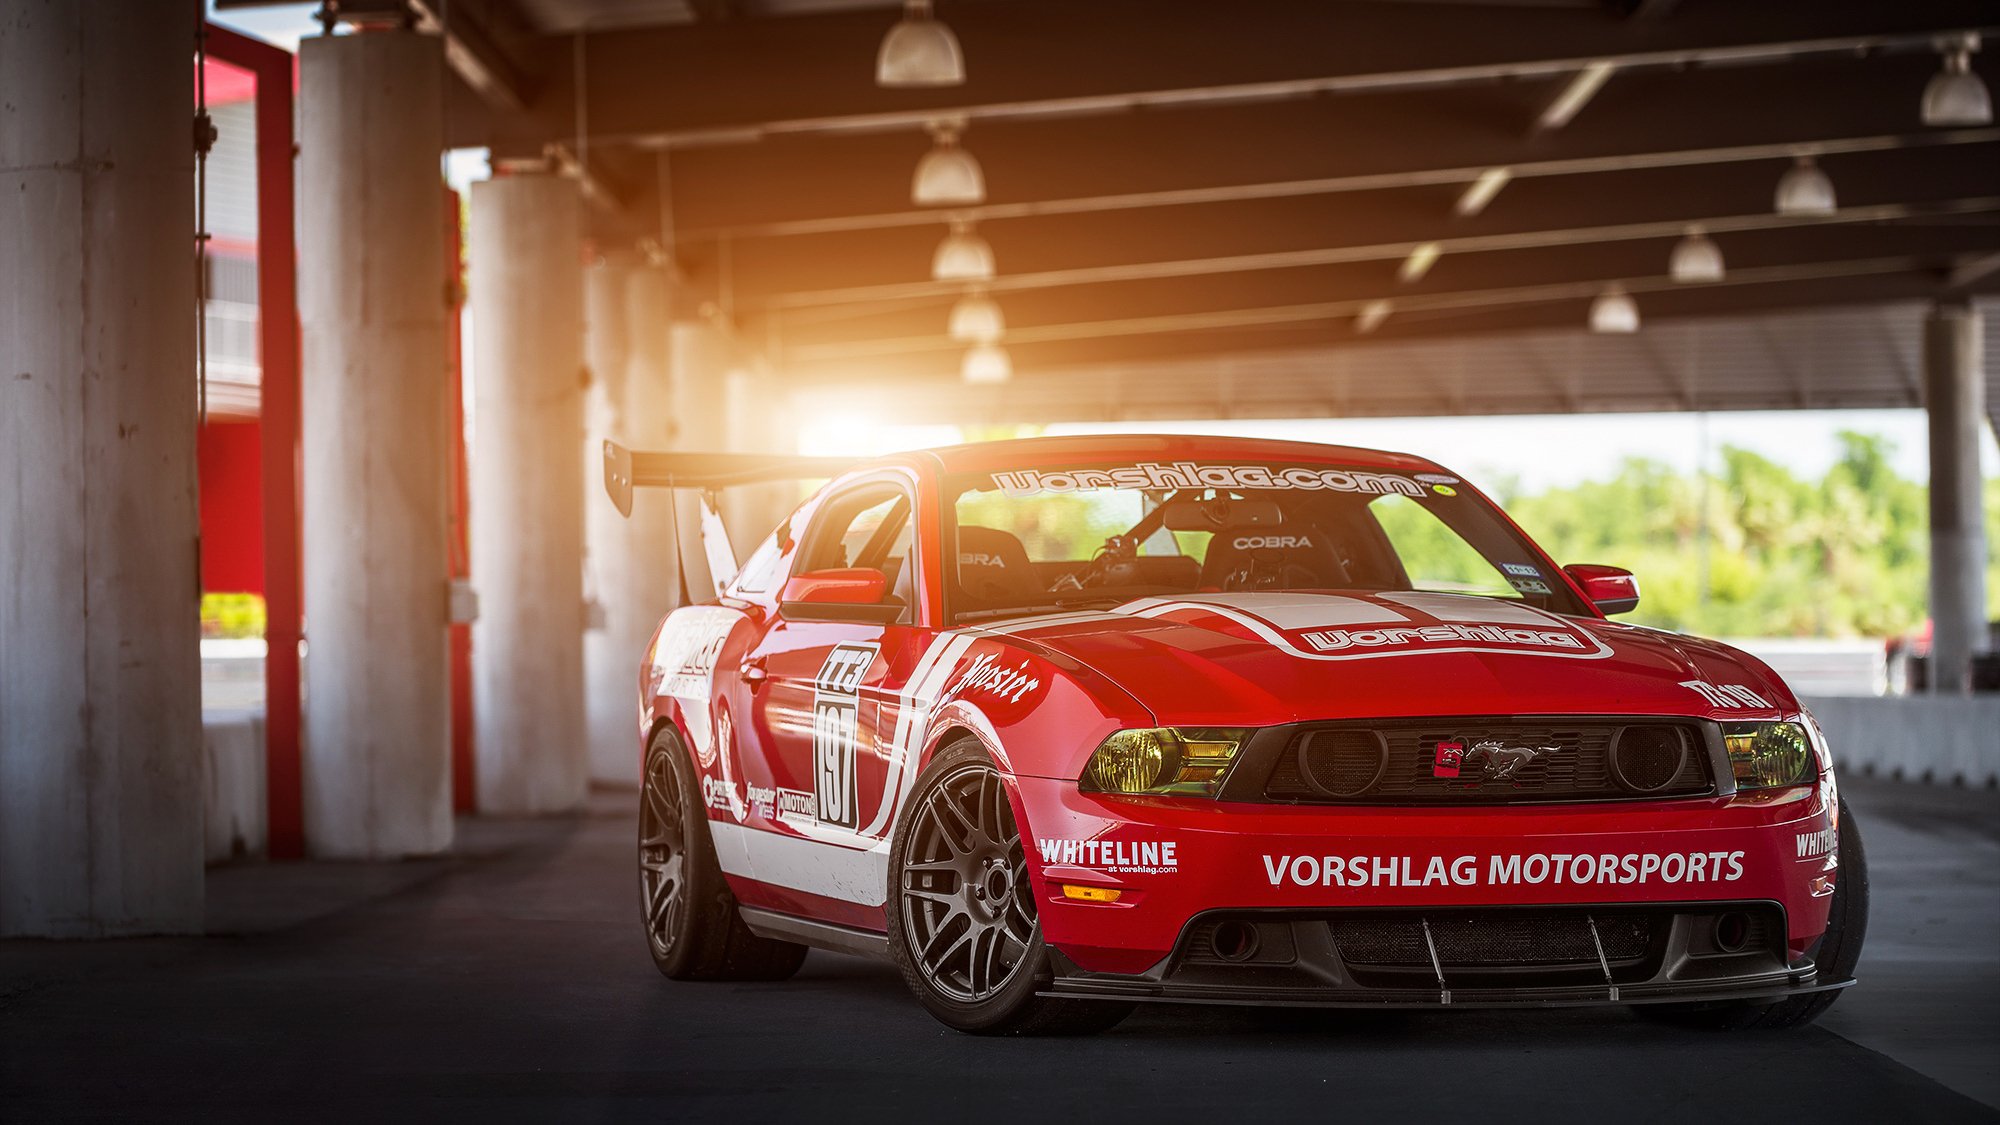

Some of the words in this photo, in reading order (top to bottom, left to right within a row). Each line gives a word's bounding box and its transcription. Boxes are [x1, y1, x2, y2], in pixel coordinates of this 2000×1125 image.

[1233, 536, 1313, 549] COBRA
[959, 553, 1005, 568] BRA
[821, 650, 873, 693] TT3
[954, 653, 1039, 704] Hoosier
[817, 705, 856, 824] 197
[784, 793, 812, 816] MOTON
[1040, 839, 1177, 866] WHITELINE
[1796, 830, 1837, 858] WHITEE
[1119, 866, 1178, 875] vorshlag.com
[1262, 855, 1478, 887] VORSHLAG
[1487, 851, 1745, 885] MOTORSPORTS
